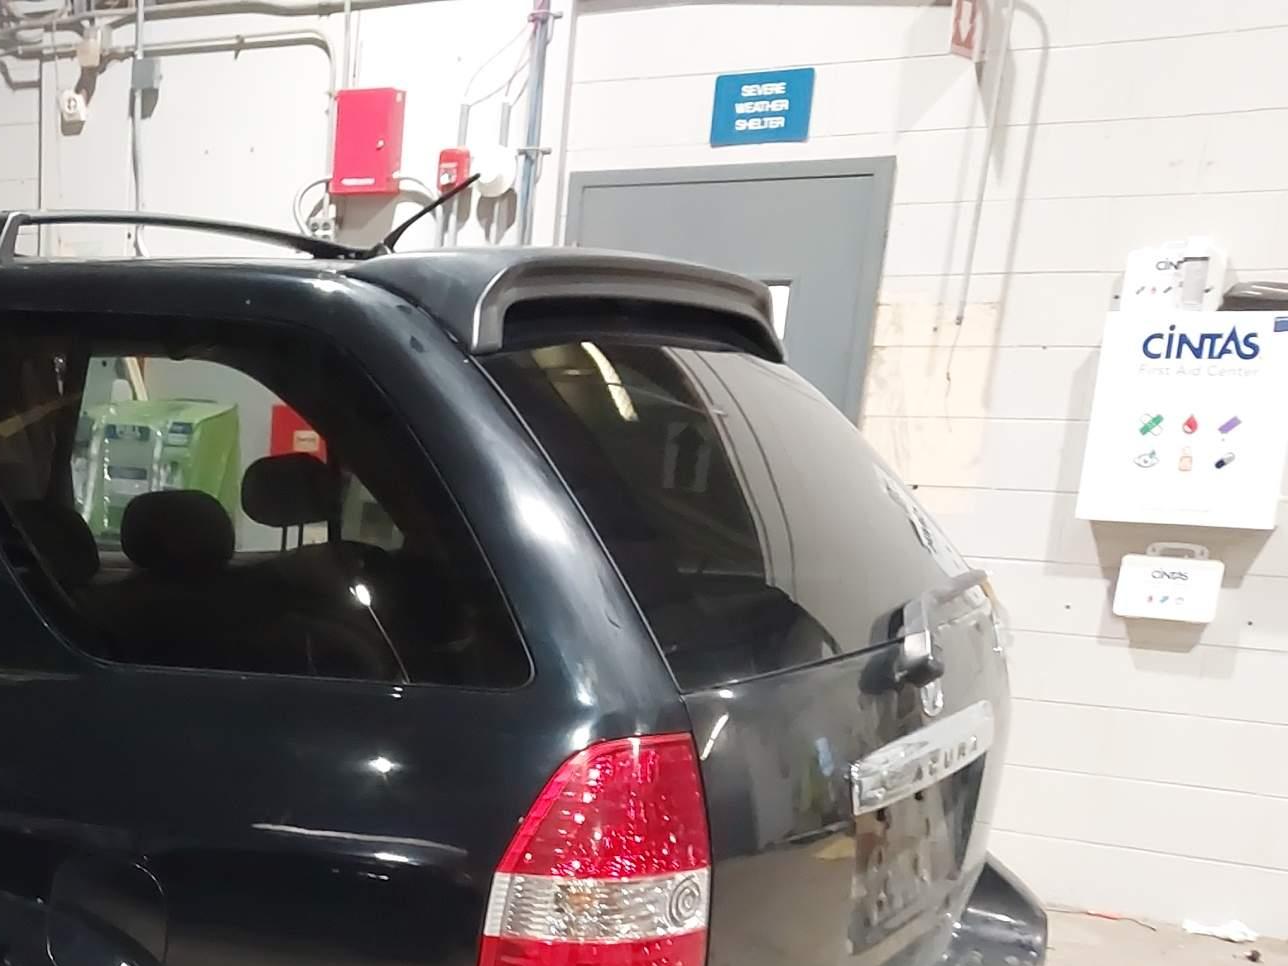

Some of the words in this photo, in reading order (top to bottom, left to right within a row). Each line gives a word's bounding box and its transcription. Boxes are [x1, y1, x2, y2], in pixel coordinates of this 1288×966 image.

[740, 82, 787, 97] SEVERE
[734, 99, 790, 114] WEATHER
[734, 116, 786, 131] SHELTER
[1138, 364, 1169, 376] First
[1176, 364, 1201, 376] Aid
[1207, 365, 1259, 377] Center
